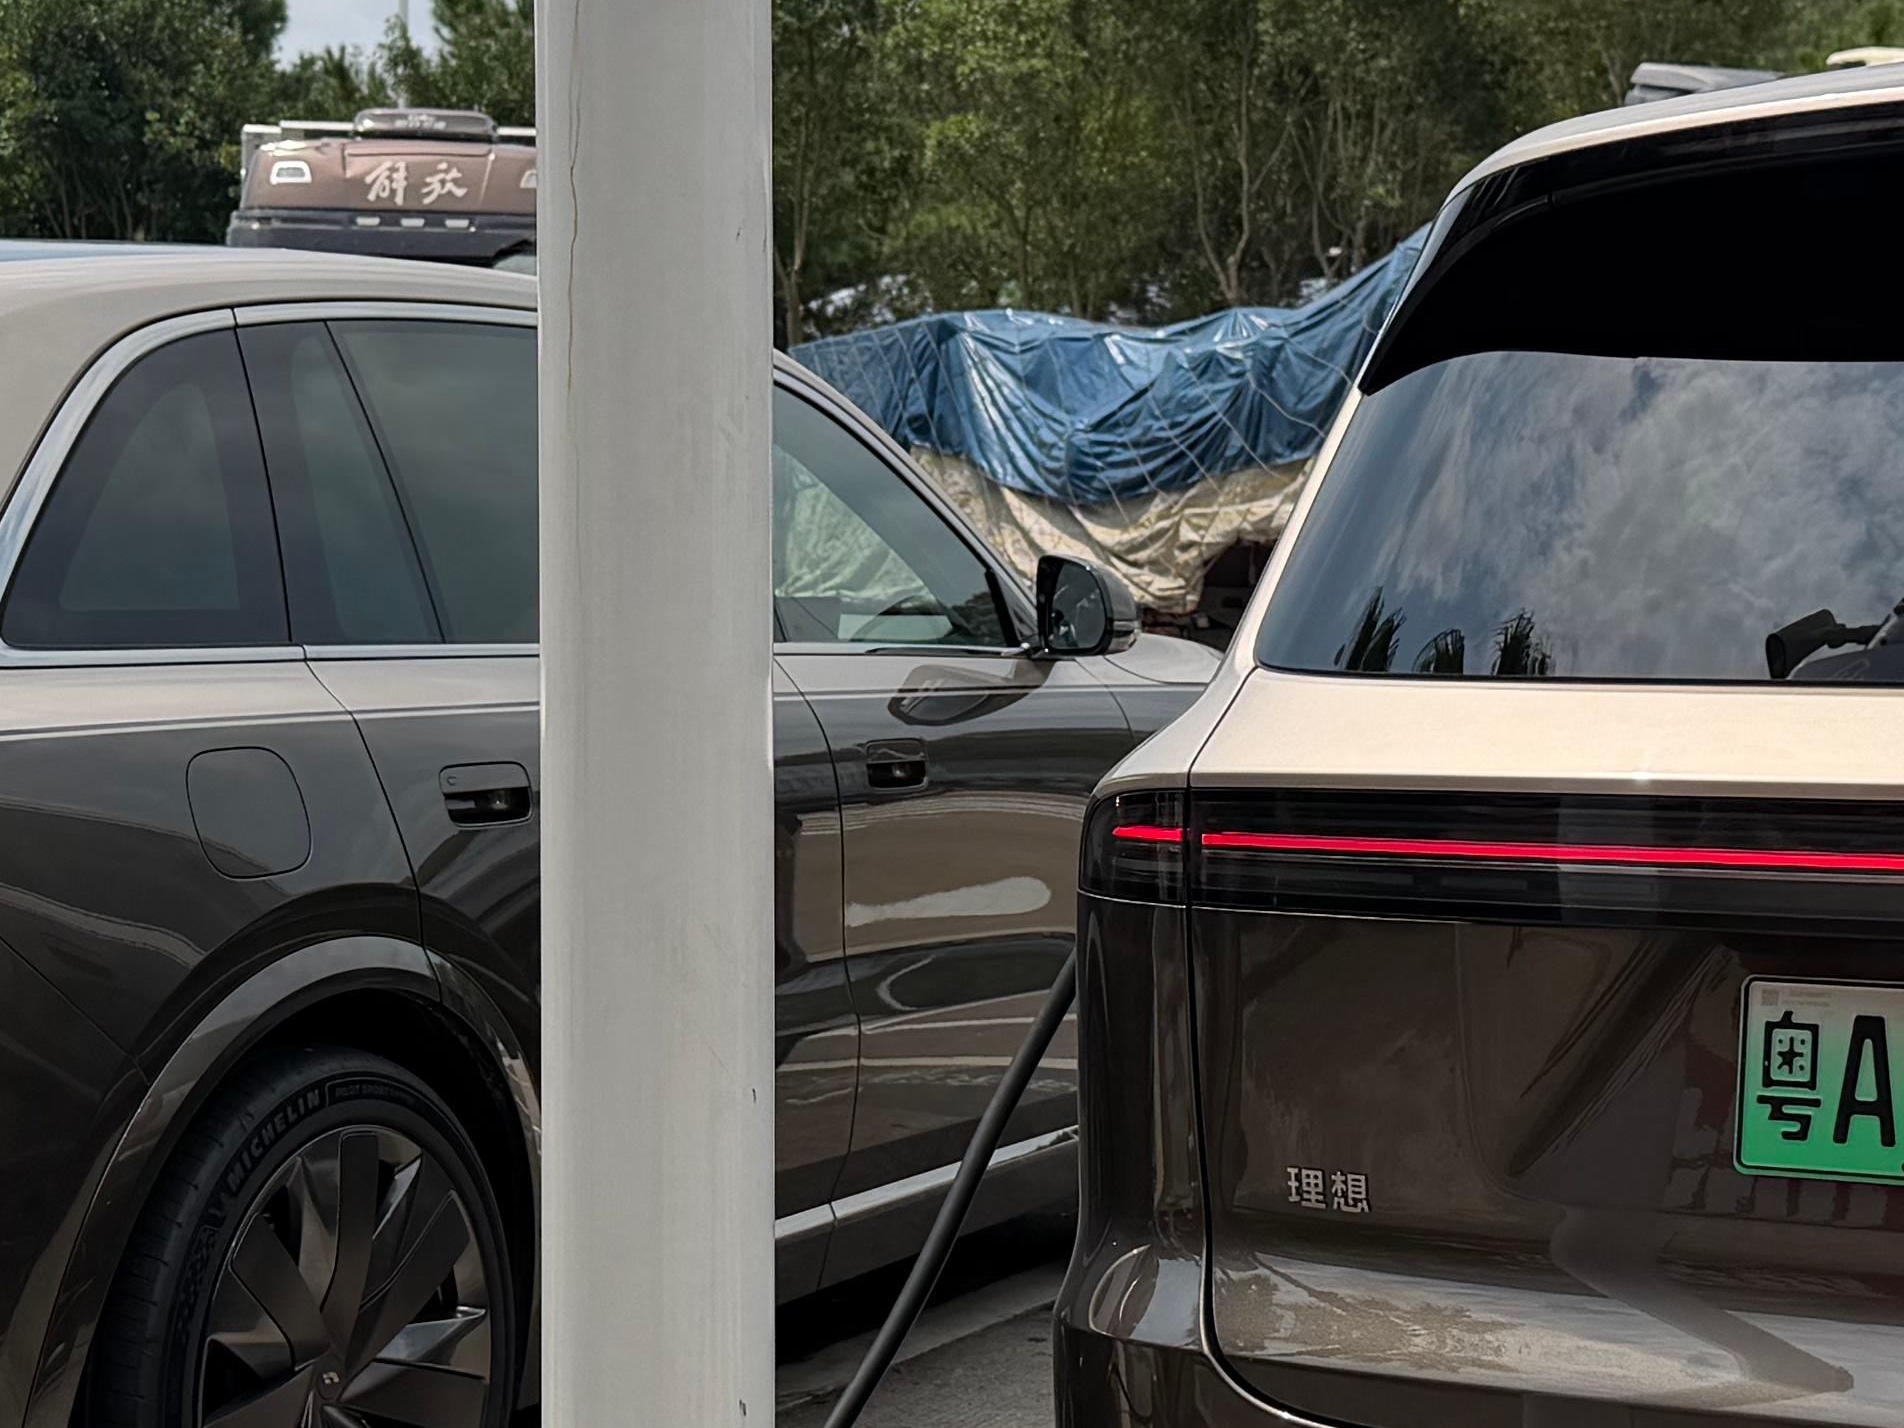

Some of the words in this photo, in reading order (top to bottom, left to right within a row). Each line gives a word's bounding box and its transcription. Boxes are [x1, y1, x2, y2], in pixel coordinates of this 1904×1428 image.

[363, 160, 468, 206] 解放
[226, 1087, 322, 1194] MICHELIN
[1286, 1166, 1371, 1213] 理想
